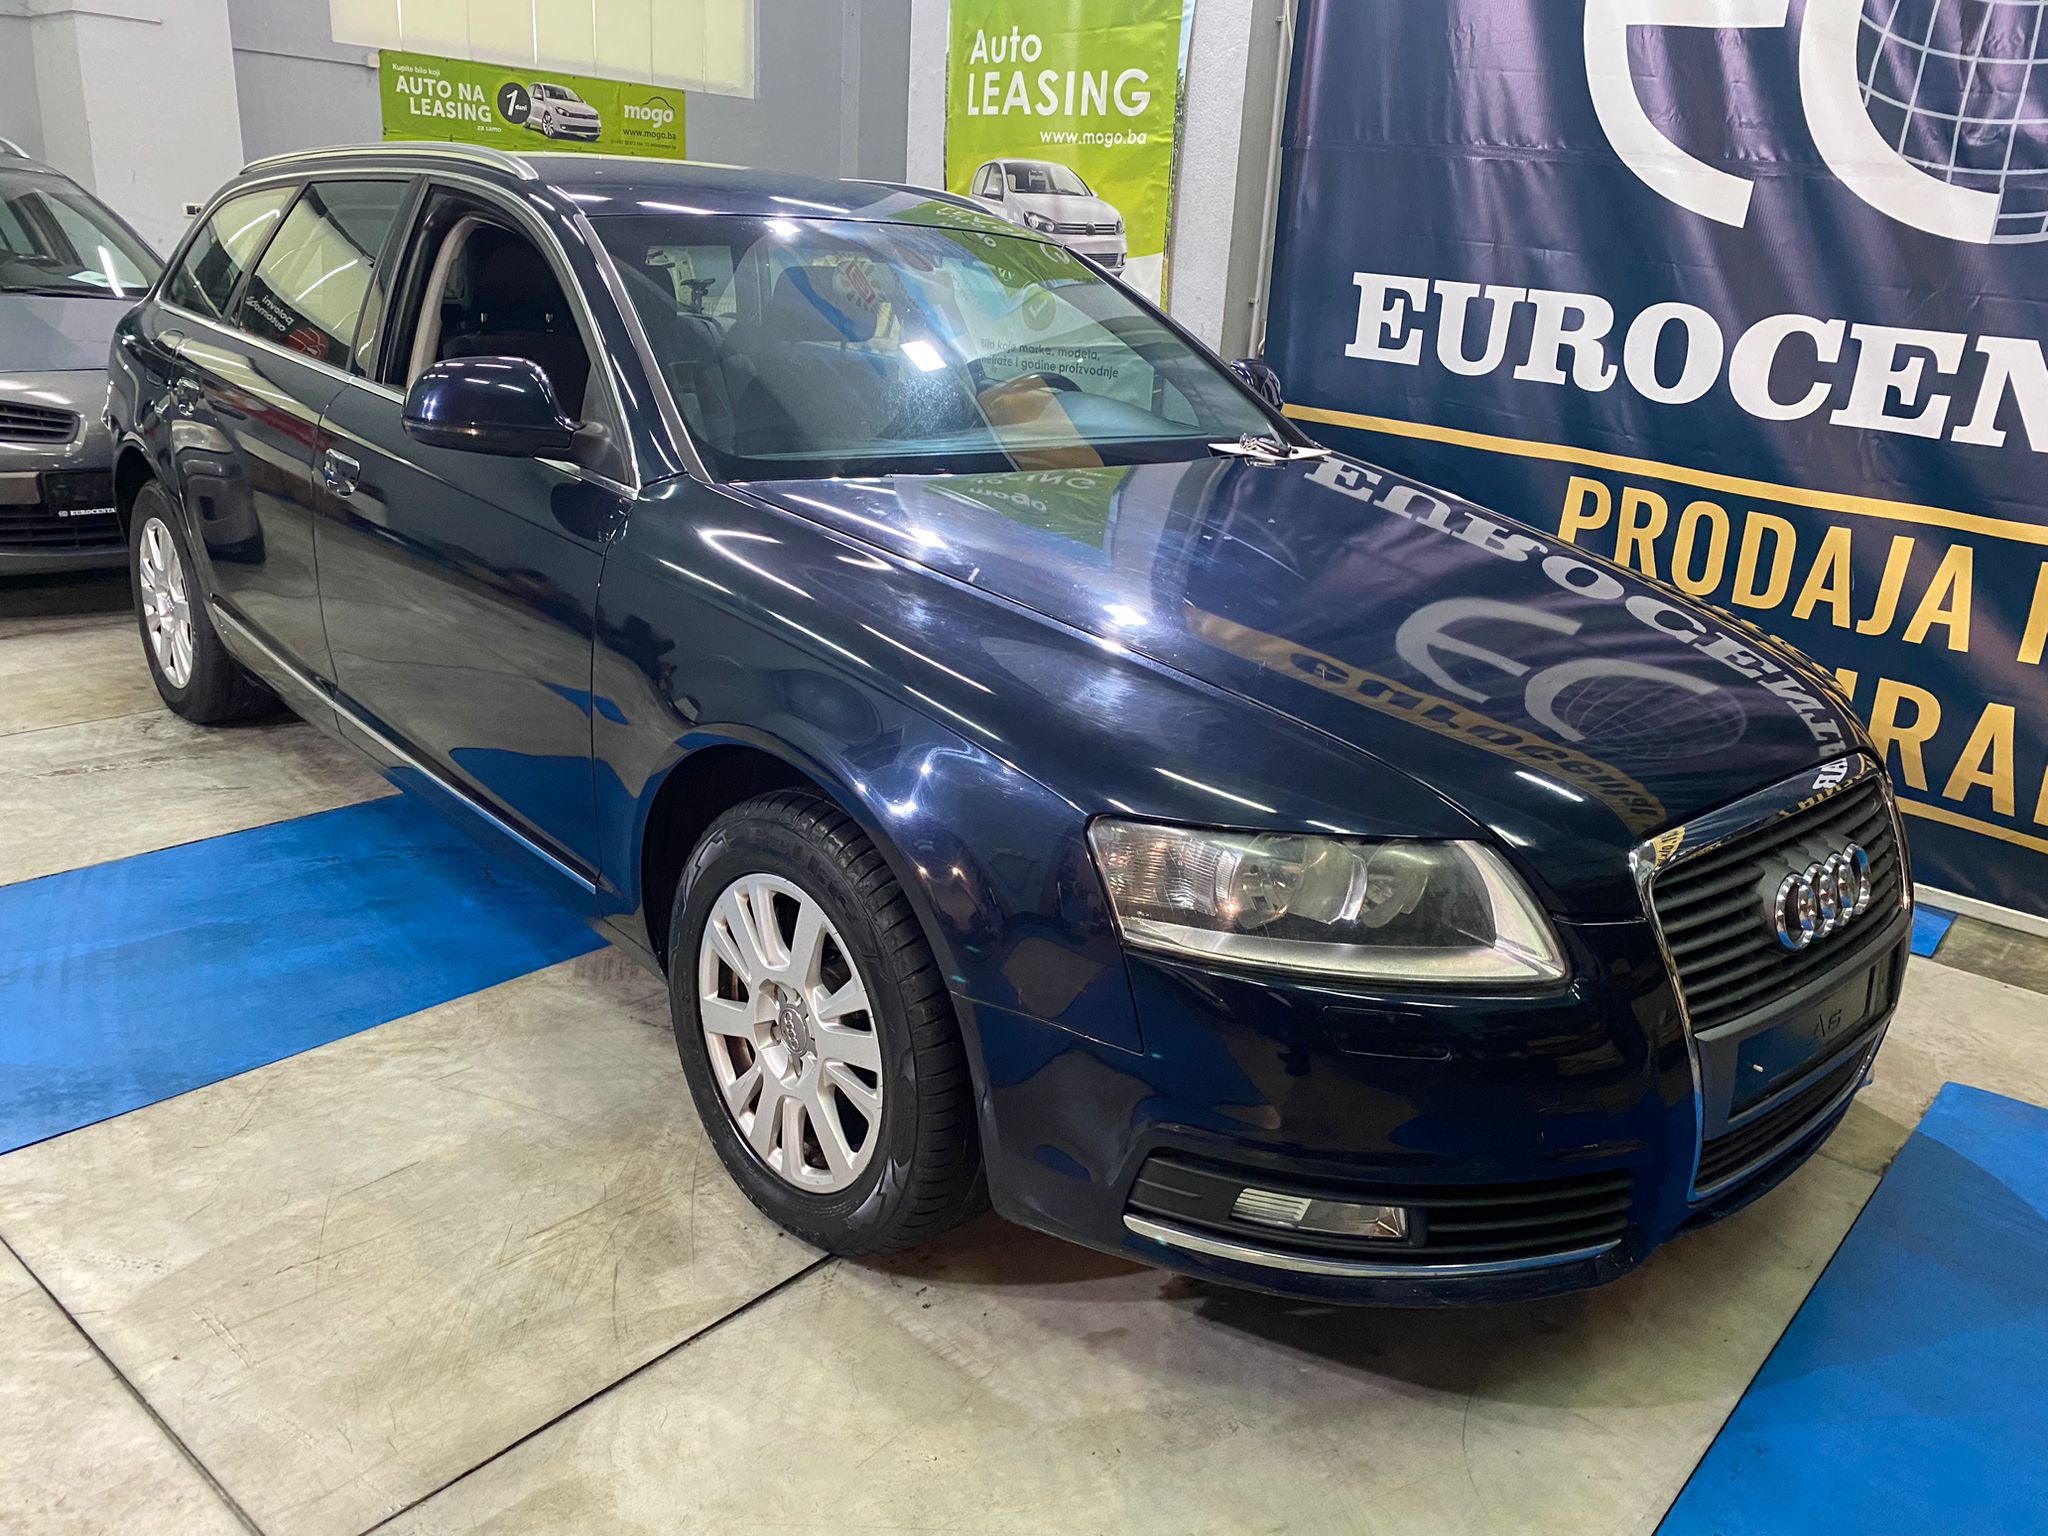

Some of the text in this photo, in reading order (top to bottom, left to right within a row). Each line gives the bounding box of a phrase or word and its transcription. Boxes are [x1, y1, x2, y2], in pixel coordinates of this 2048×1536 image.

[969, 25, 1043, 65] Auto
[392, 63, 441, 77] Kupite bilo koji
[396, 75, 485, 102] AUTO NA
[967, 68, 1151, 117] LEASING
[410, 97, 492, 123] LEASING
[506, 90, 518, 116] 1
[624, 105, 674, 128] mogo
[623, 129, 677, 140] www.mogo.ba
[1040, 128, 1147, 148] www.mogo.ba
[1021, 359, 1056, 371] godine
[1059, 362, 1119, 380] proizvodnje
[70, 507, 117, 516] EUROCENTA
[1557, 475, 1974, 653] PRODAJA
